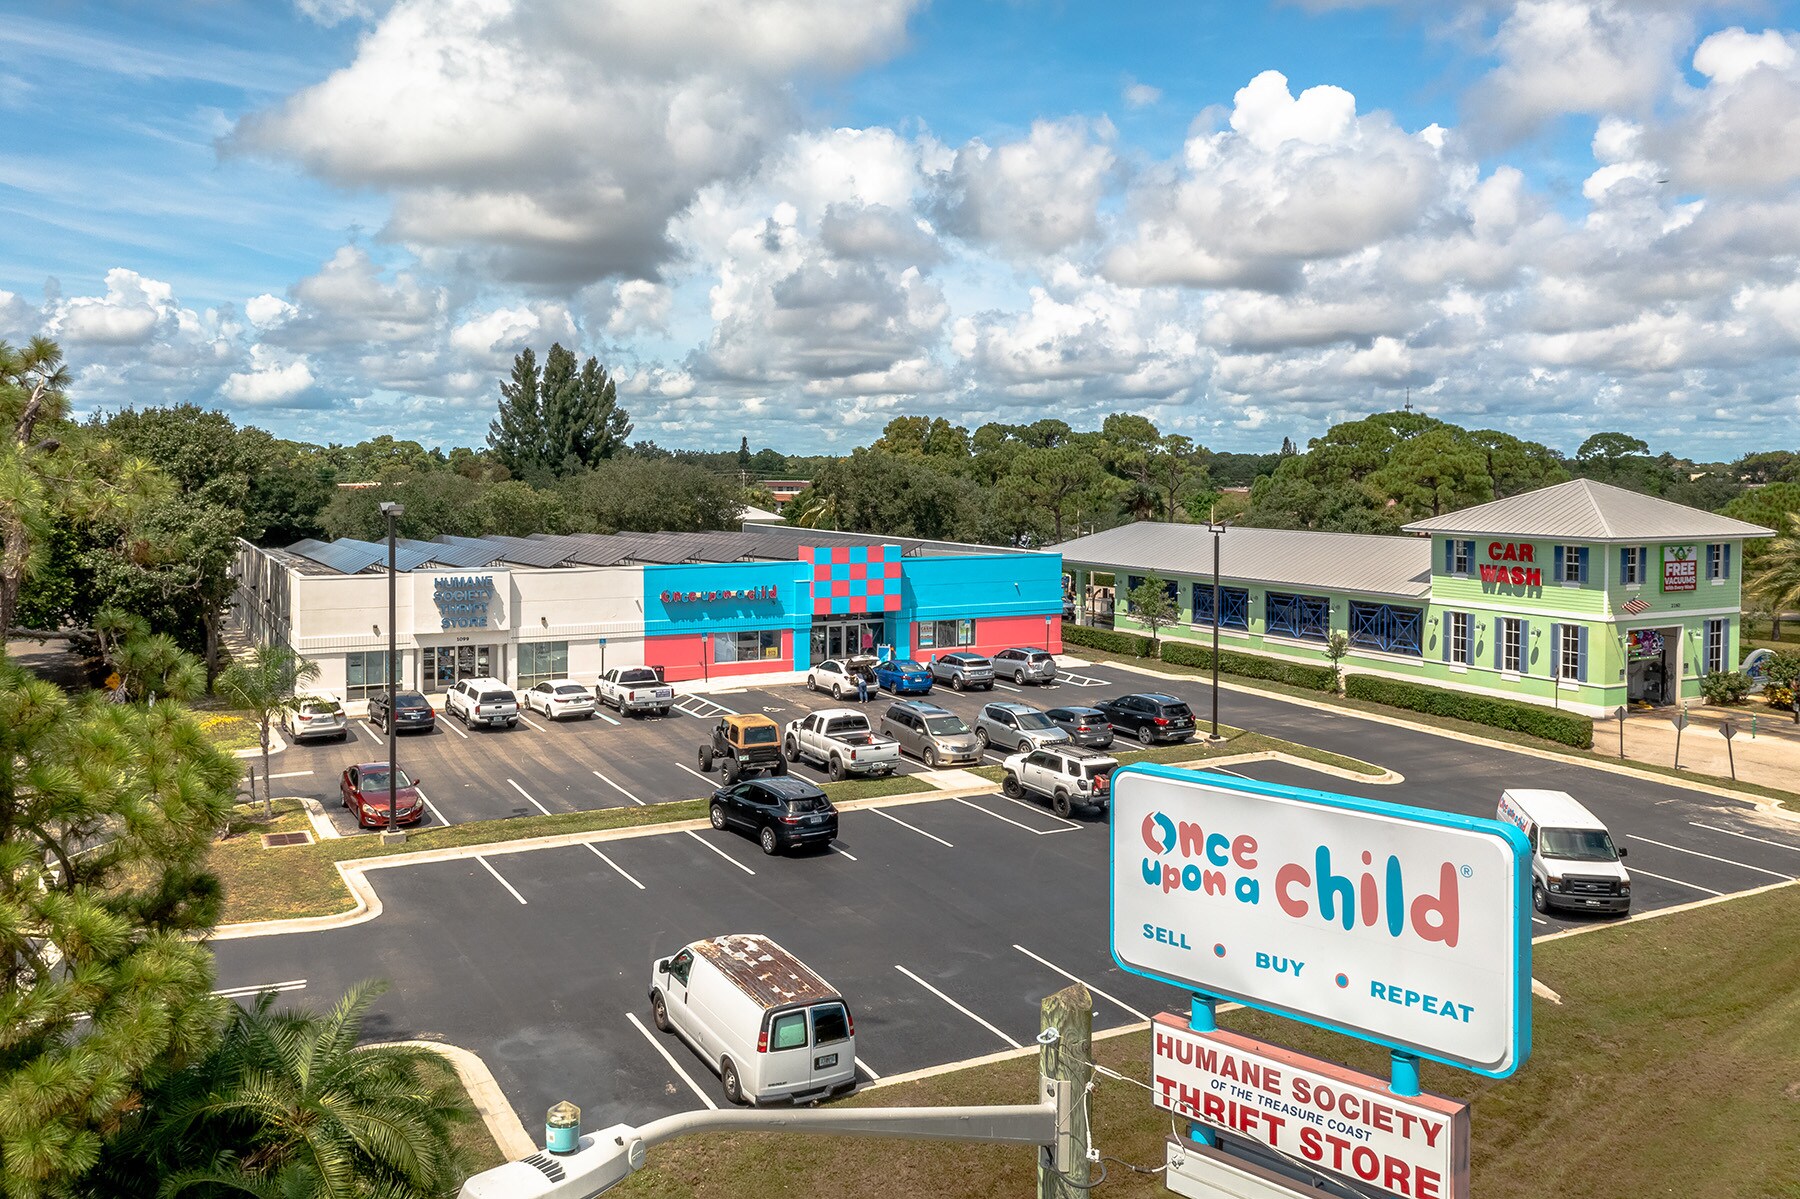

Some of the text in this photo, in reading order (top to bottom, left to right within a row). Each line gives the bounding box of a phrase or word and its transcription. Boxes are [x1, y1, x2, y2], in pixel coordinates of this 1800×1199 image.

[1488, 541, 1535, 563] CAR
[1479, 563, 1542, 587] WASH
[1665, 562, 1695, 576] FREE
[434, 576, 493, 588] HUMANE
[1664, 576, 1696, 585] VACUUMS
[433, 589, 493, 601] SOCIETY
[661, 584, 777, 603] Once upon a child
[440, 602, 488, 615] THRIFT
[441, 616, 487, 629] STORE
[1141, 811, 1258, 870] Once
[1142, 857, 1226, 895] upon
[1235, 876, 1260, 905] a
[1275, 845, 1460, 948] child
[1143, 923, 1475, 1023] SELL BUY REPEAT
[1156, 1032, 1443, 1148] HUMANE SOCIETY
[1210, 1079, 1372, 1142] OF THE TREASURE COAST
[1156, 1074, 1441, 1199] THRIFT STORE
